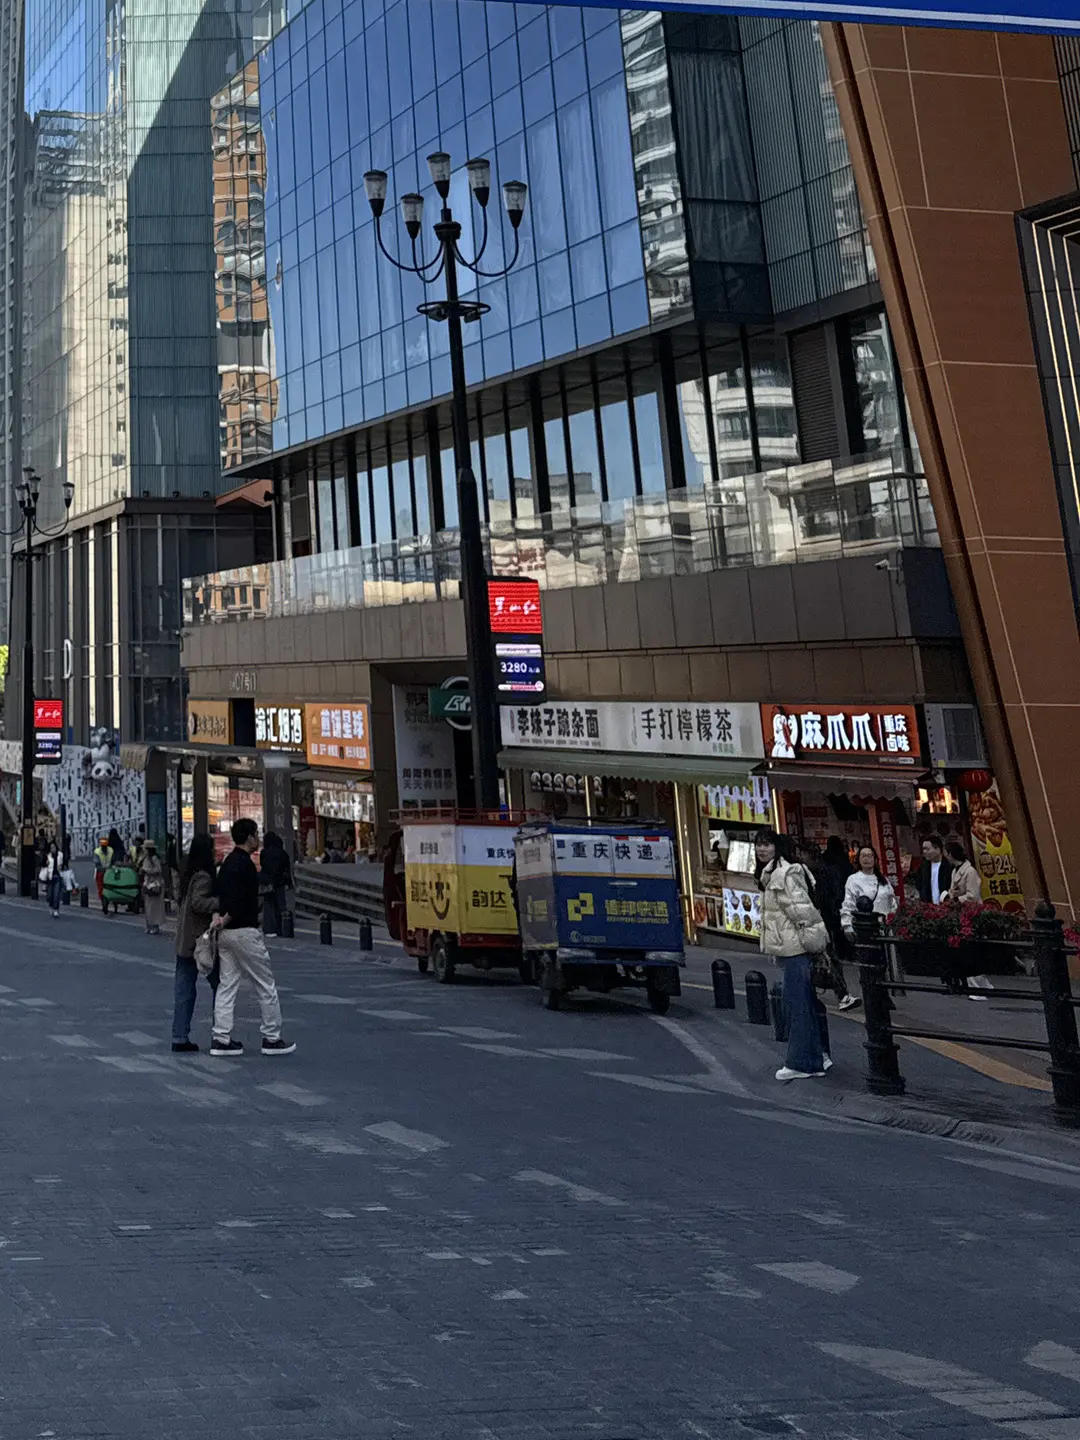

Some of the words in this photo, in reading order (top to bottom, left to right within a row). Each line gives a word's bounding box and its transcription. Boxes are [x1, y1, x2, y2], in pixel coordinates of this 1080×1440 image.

[500, 662, 528, 673] 3280
[255, 708, 302, 744] 渝汇烟酒
[641, 708, 733, 743] 手打檸檬茶
[800, 711, 877, 751] 麻爪爪
[883, 714, 906, 733] 重庆
[886, 734, 910, 752] 卤味
[571, 841, 654, 860] 重庆快递
[472, 890, 508, 908] 韵达
